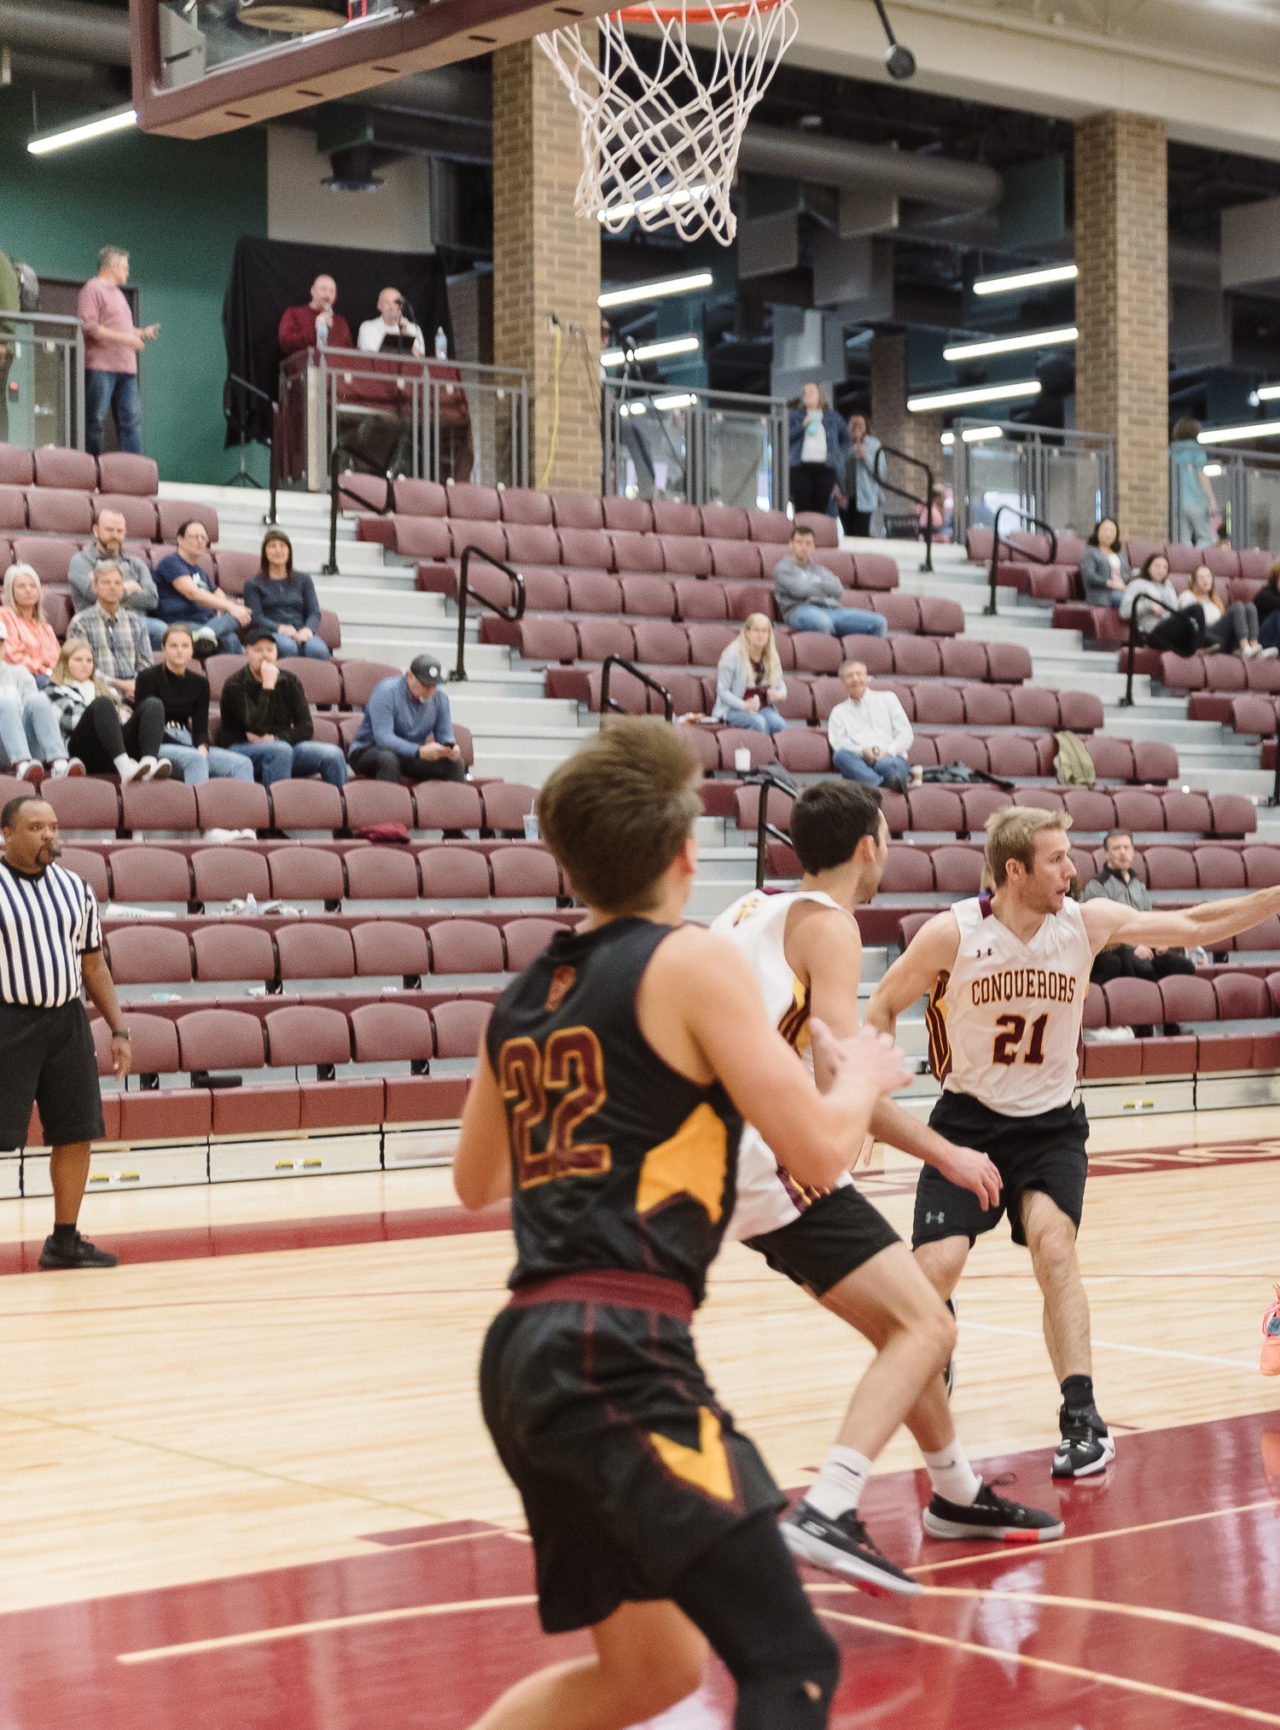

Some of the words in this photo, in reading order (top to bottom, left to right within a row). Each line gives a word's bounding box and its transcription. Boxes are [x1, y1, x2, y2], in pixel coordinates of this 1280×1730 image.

[971, 968, 1076, 1007] CONQUERORS
[992, 1013, 1048, 1067] 21
[500, 1025, 612, 1190] 22
